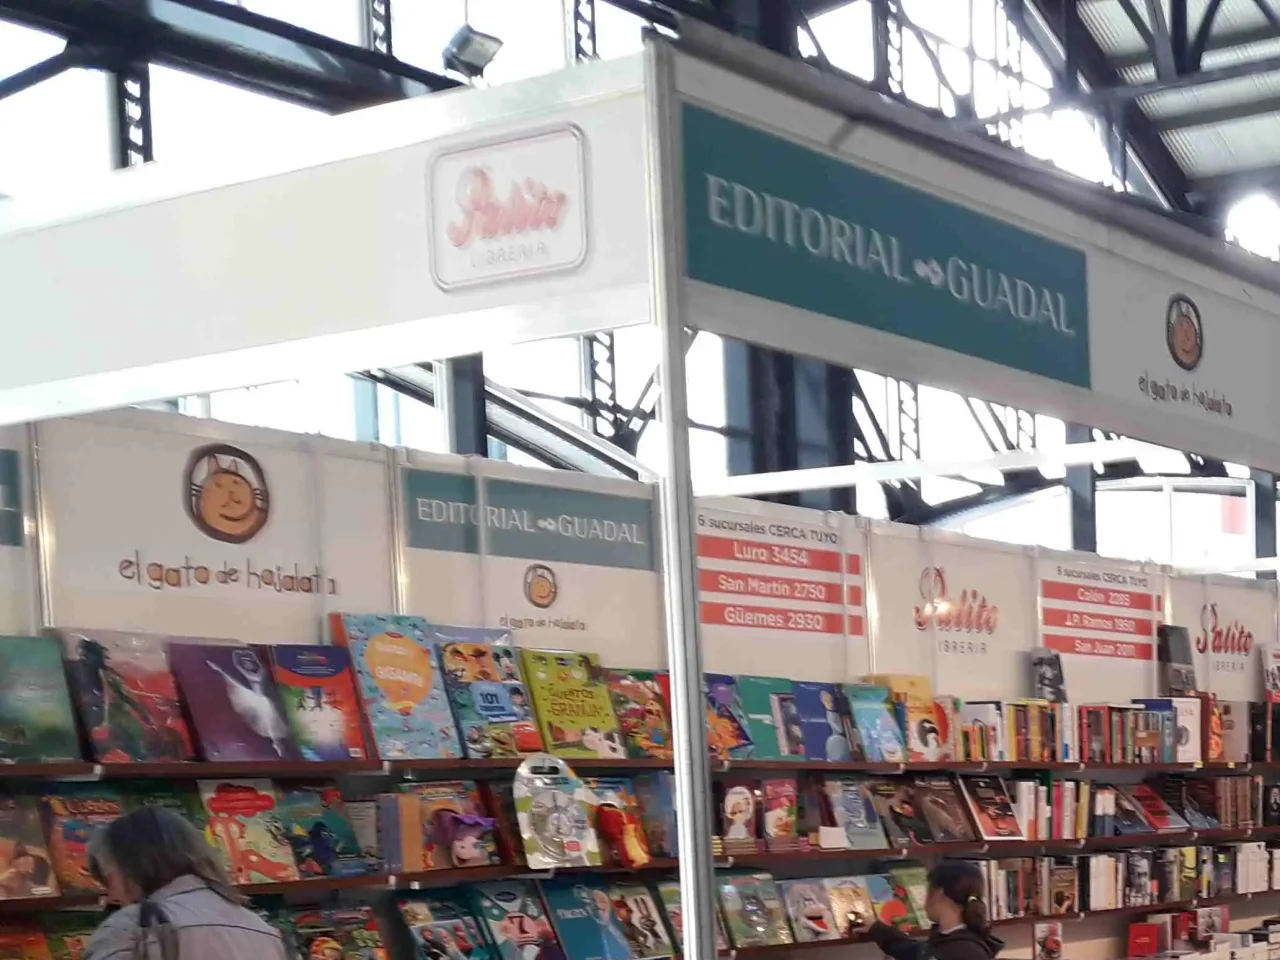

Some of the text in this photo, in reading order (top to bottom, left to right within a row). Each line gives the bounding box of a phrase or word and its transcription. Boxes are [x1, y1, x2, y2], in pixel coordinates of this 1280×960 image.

[703, 172, 1077, 336] EDITORIAL GUADAL
[416, 498, 645, 545] EDITORIAL GUADAL
[768, 524, 807, 541] CERCA
[809, 530, 839, 545] TUYO
[733, 540, 810, 567] Luro 3454
[118, 550, 141, 584] el
[147, 555, 210, 591] gato
[215, 560, 240, 585] de
[718, 573, 745, 592] San
[793, 582, 826, 600] 2750
[723, 606, 784, 627] Güemes
